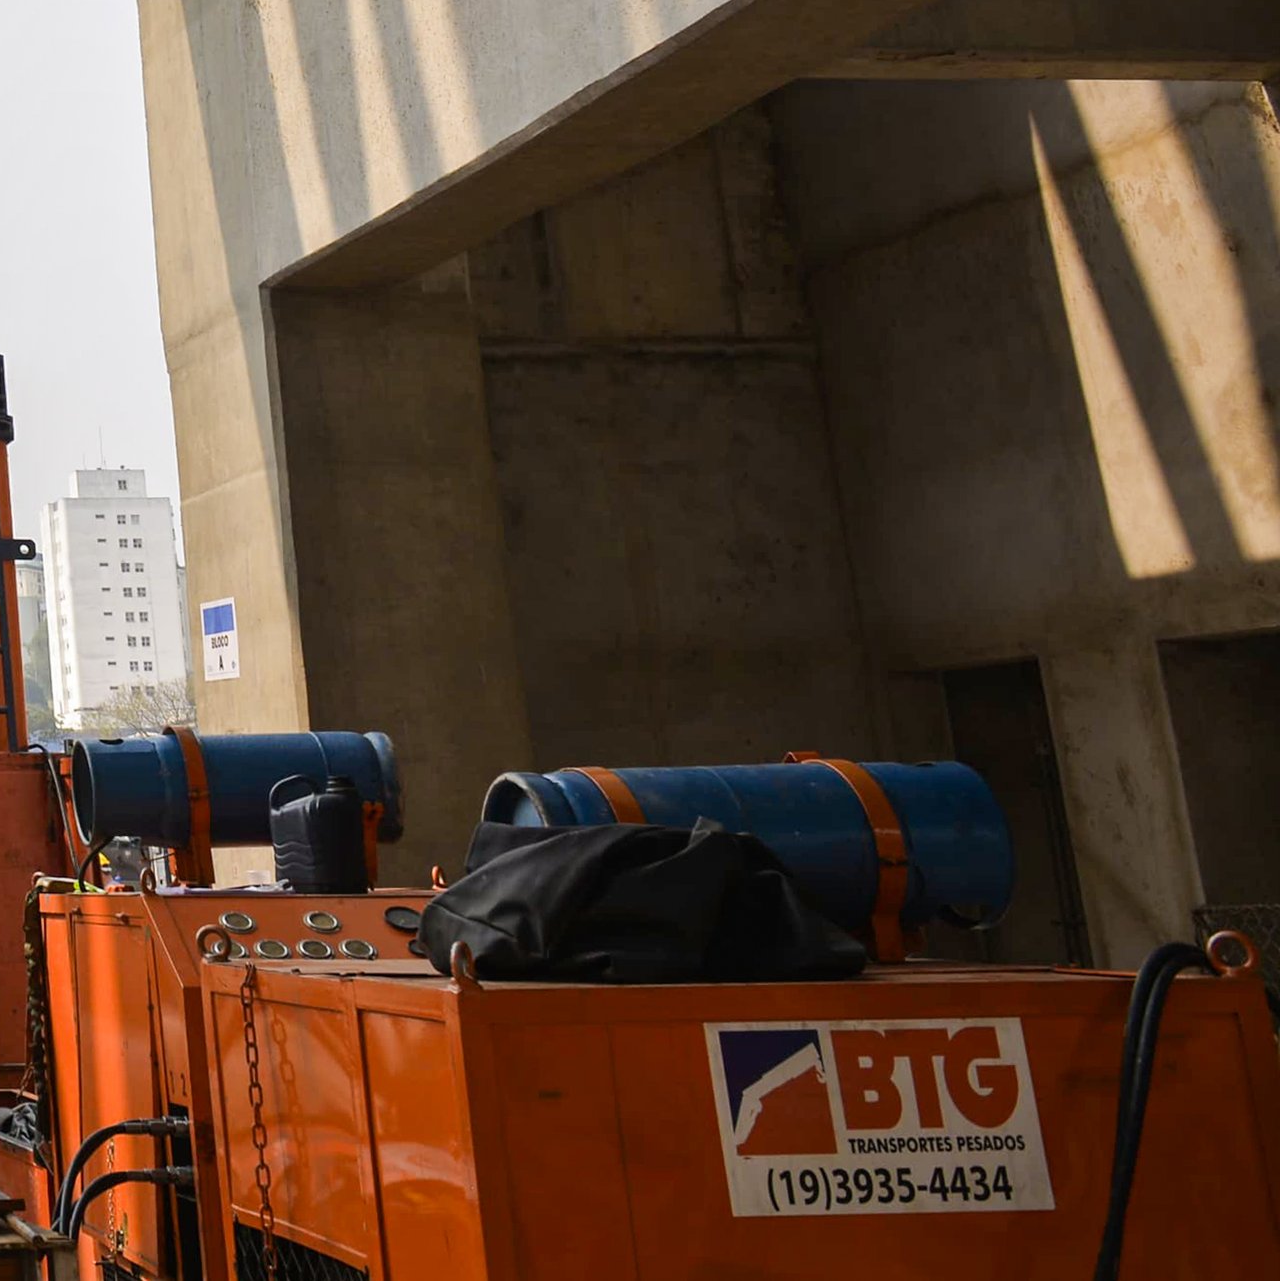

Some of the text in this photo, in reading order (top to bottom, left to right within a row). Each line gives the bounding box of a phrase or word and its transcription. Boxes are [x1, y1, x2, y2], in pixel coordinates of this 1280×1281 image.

[219, 655, 224, 671] A
[830, 1026, 1019, 1130] BTG
[848, 1135, 1026, 1154] TRANSPORTES PESADOS
[767, 1166, 1013, 1212] (19)3935-4434
